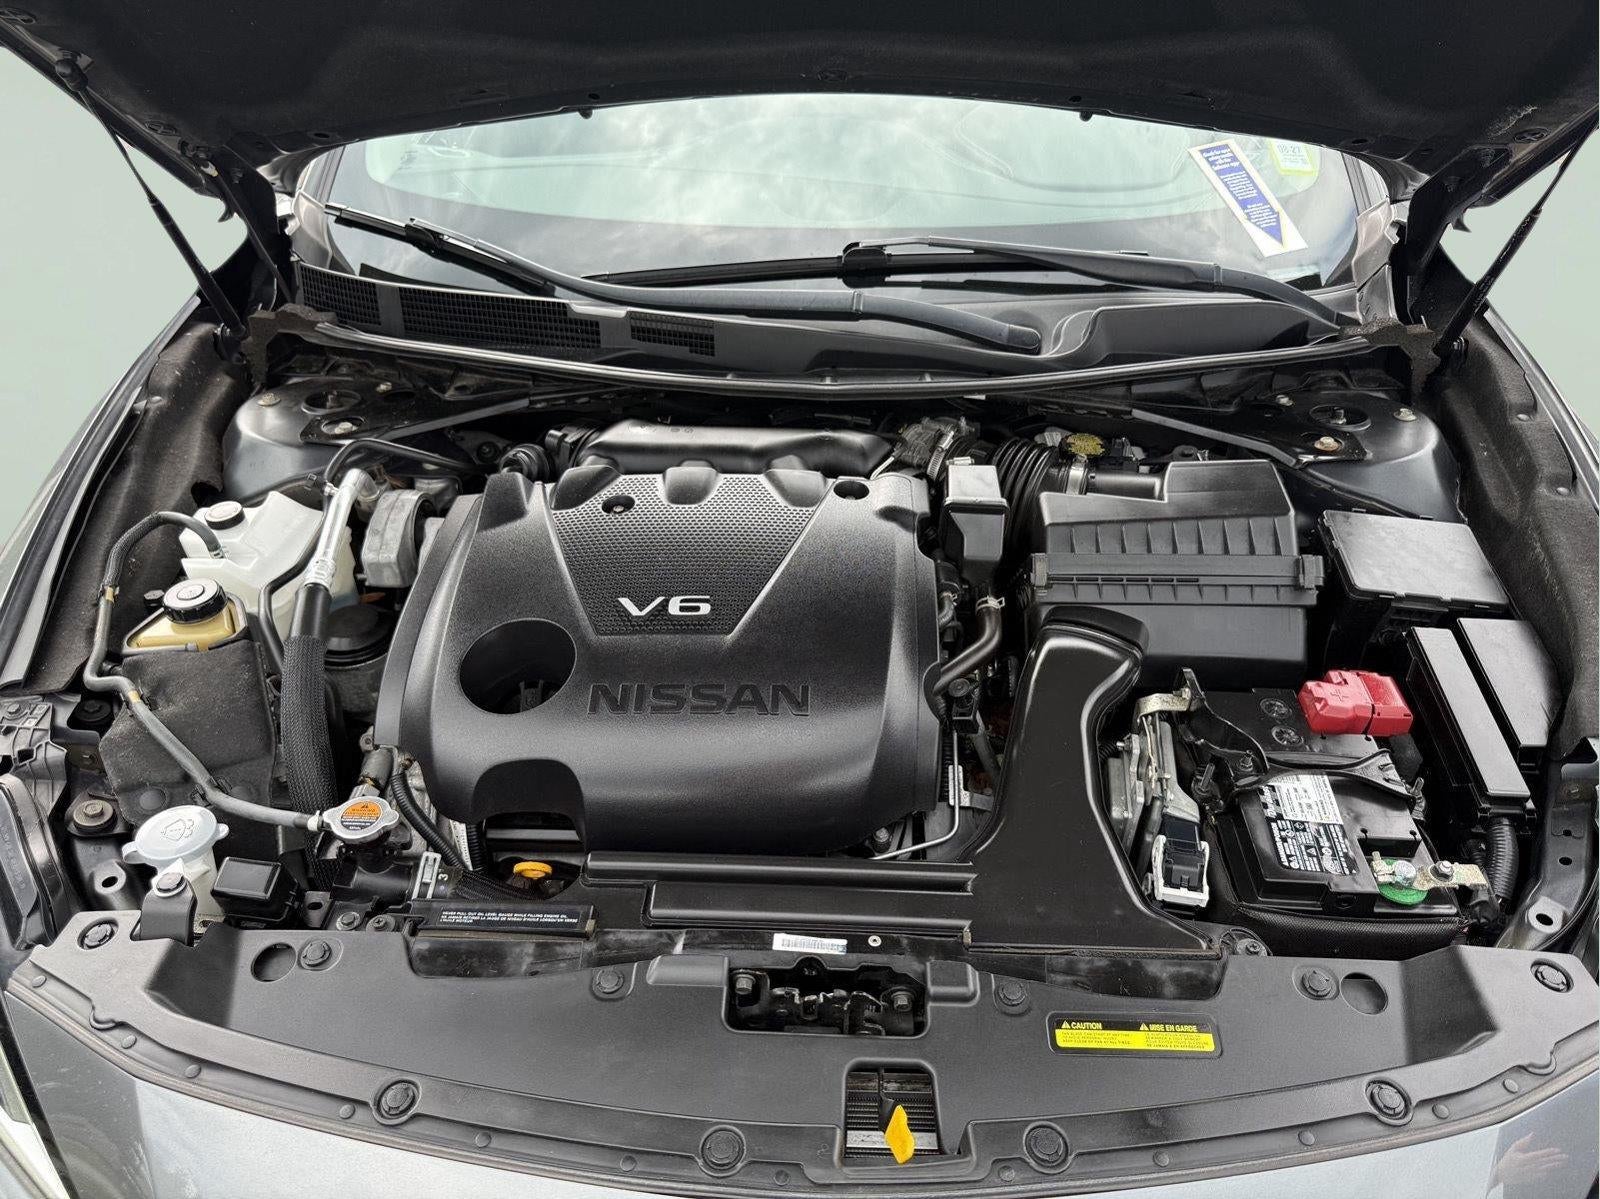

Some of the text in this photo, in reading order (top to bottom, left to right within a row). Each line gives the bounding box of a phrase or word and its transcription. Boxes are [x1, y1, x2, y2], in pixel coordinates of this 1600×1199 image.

[618, 595, 712, 616] V6
[587, 683, 811, 716] NISSAN
[1070, 1021, 1103, 1030] CAUTION
[1149, 1023, 1198, 1032] MISE EN GARDE
